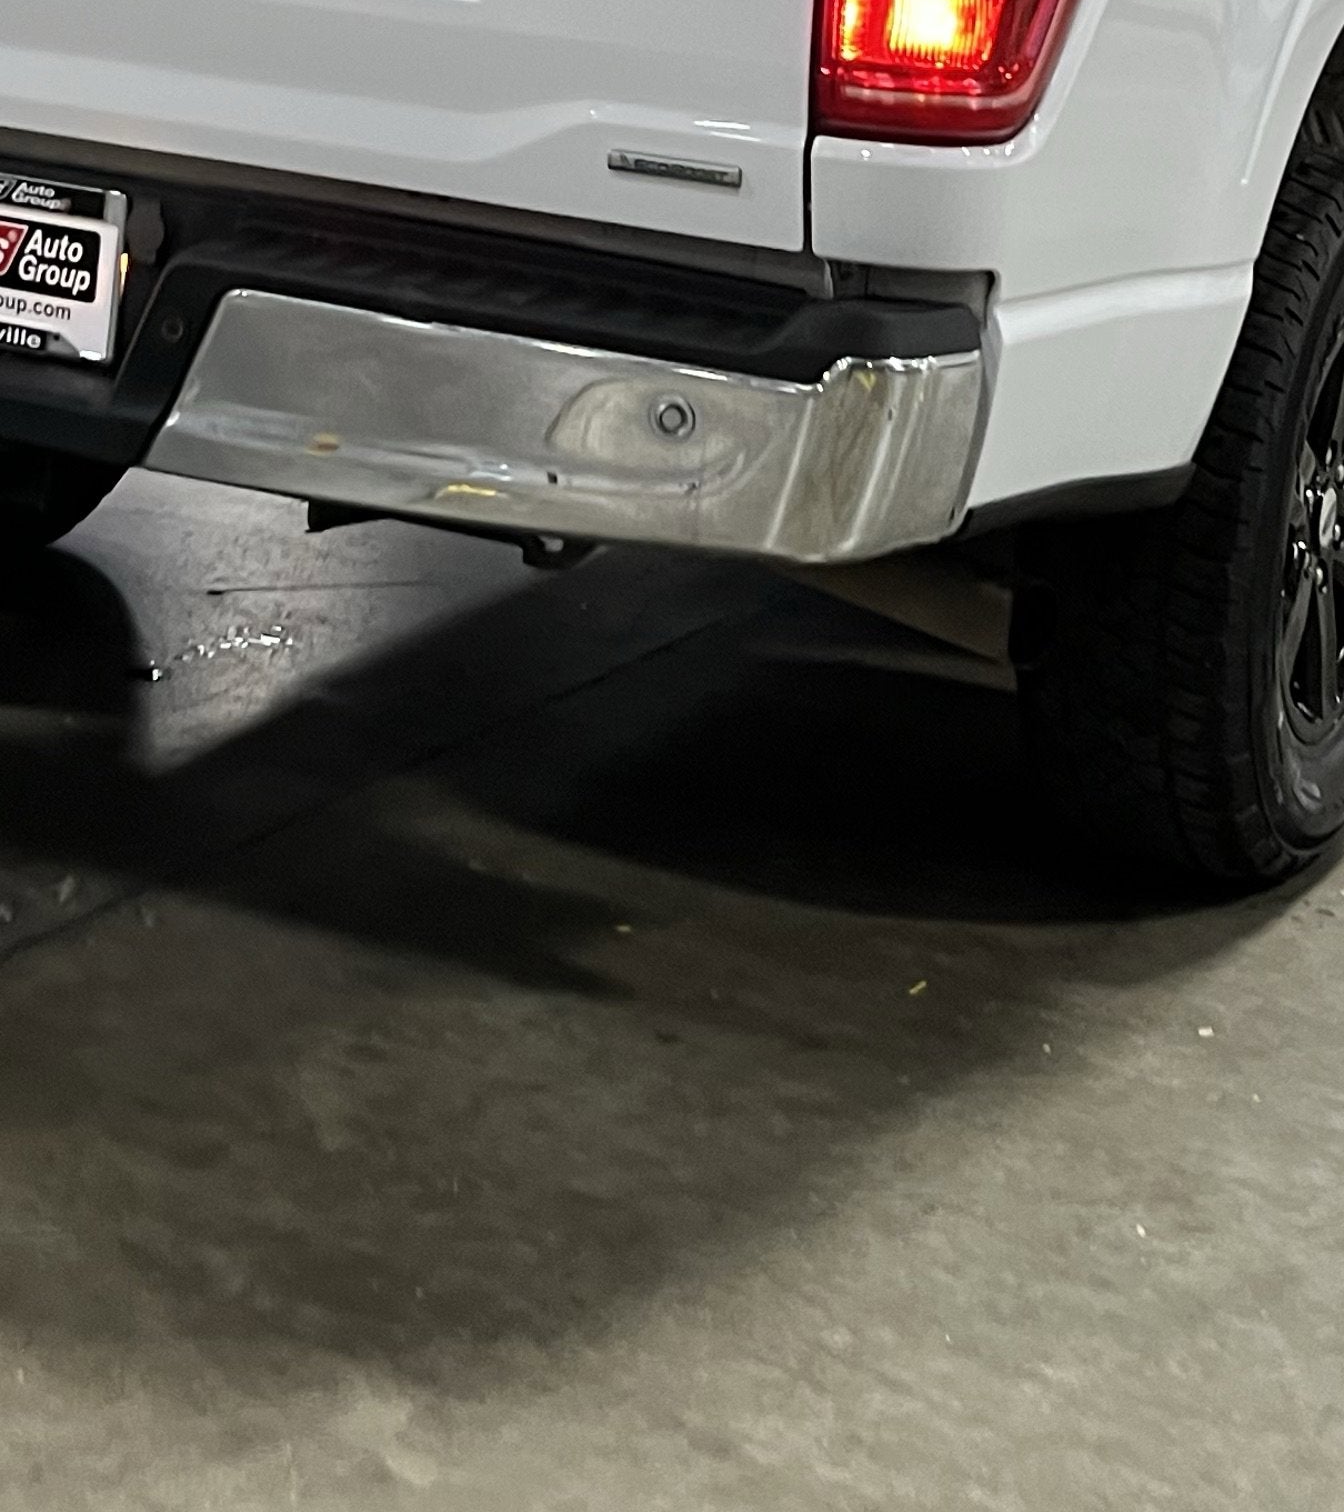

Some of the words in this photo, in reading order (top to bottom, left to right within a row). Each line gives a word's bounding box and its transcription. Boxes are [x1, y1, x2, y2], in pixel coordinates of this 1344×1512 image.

[12, 190, 62, 210] Group
[17, 182, 55, 198] Auto
[24, 229, 83, 263] Auto
[18, 255, 91, 296] Group
